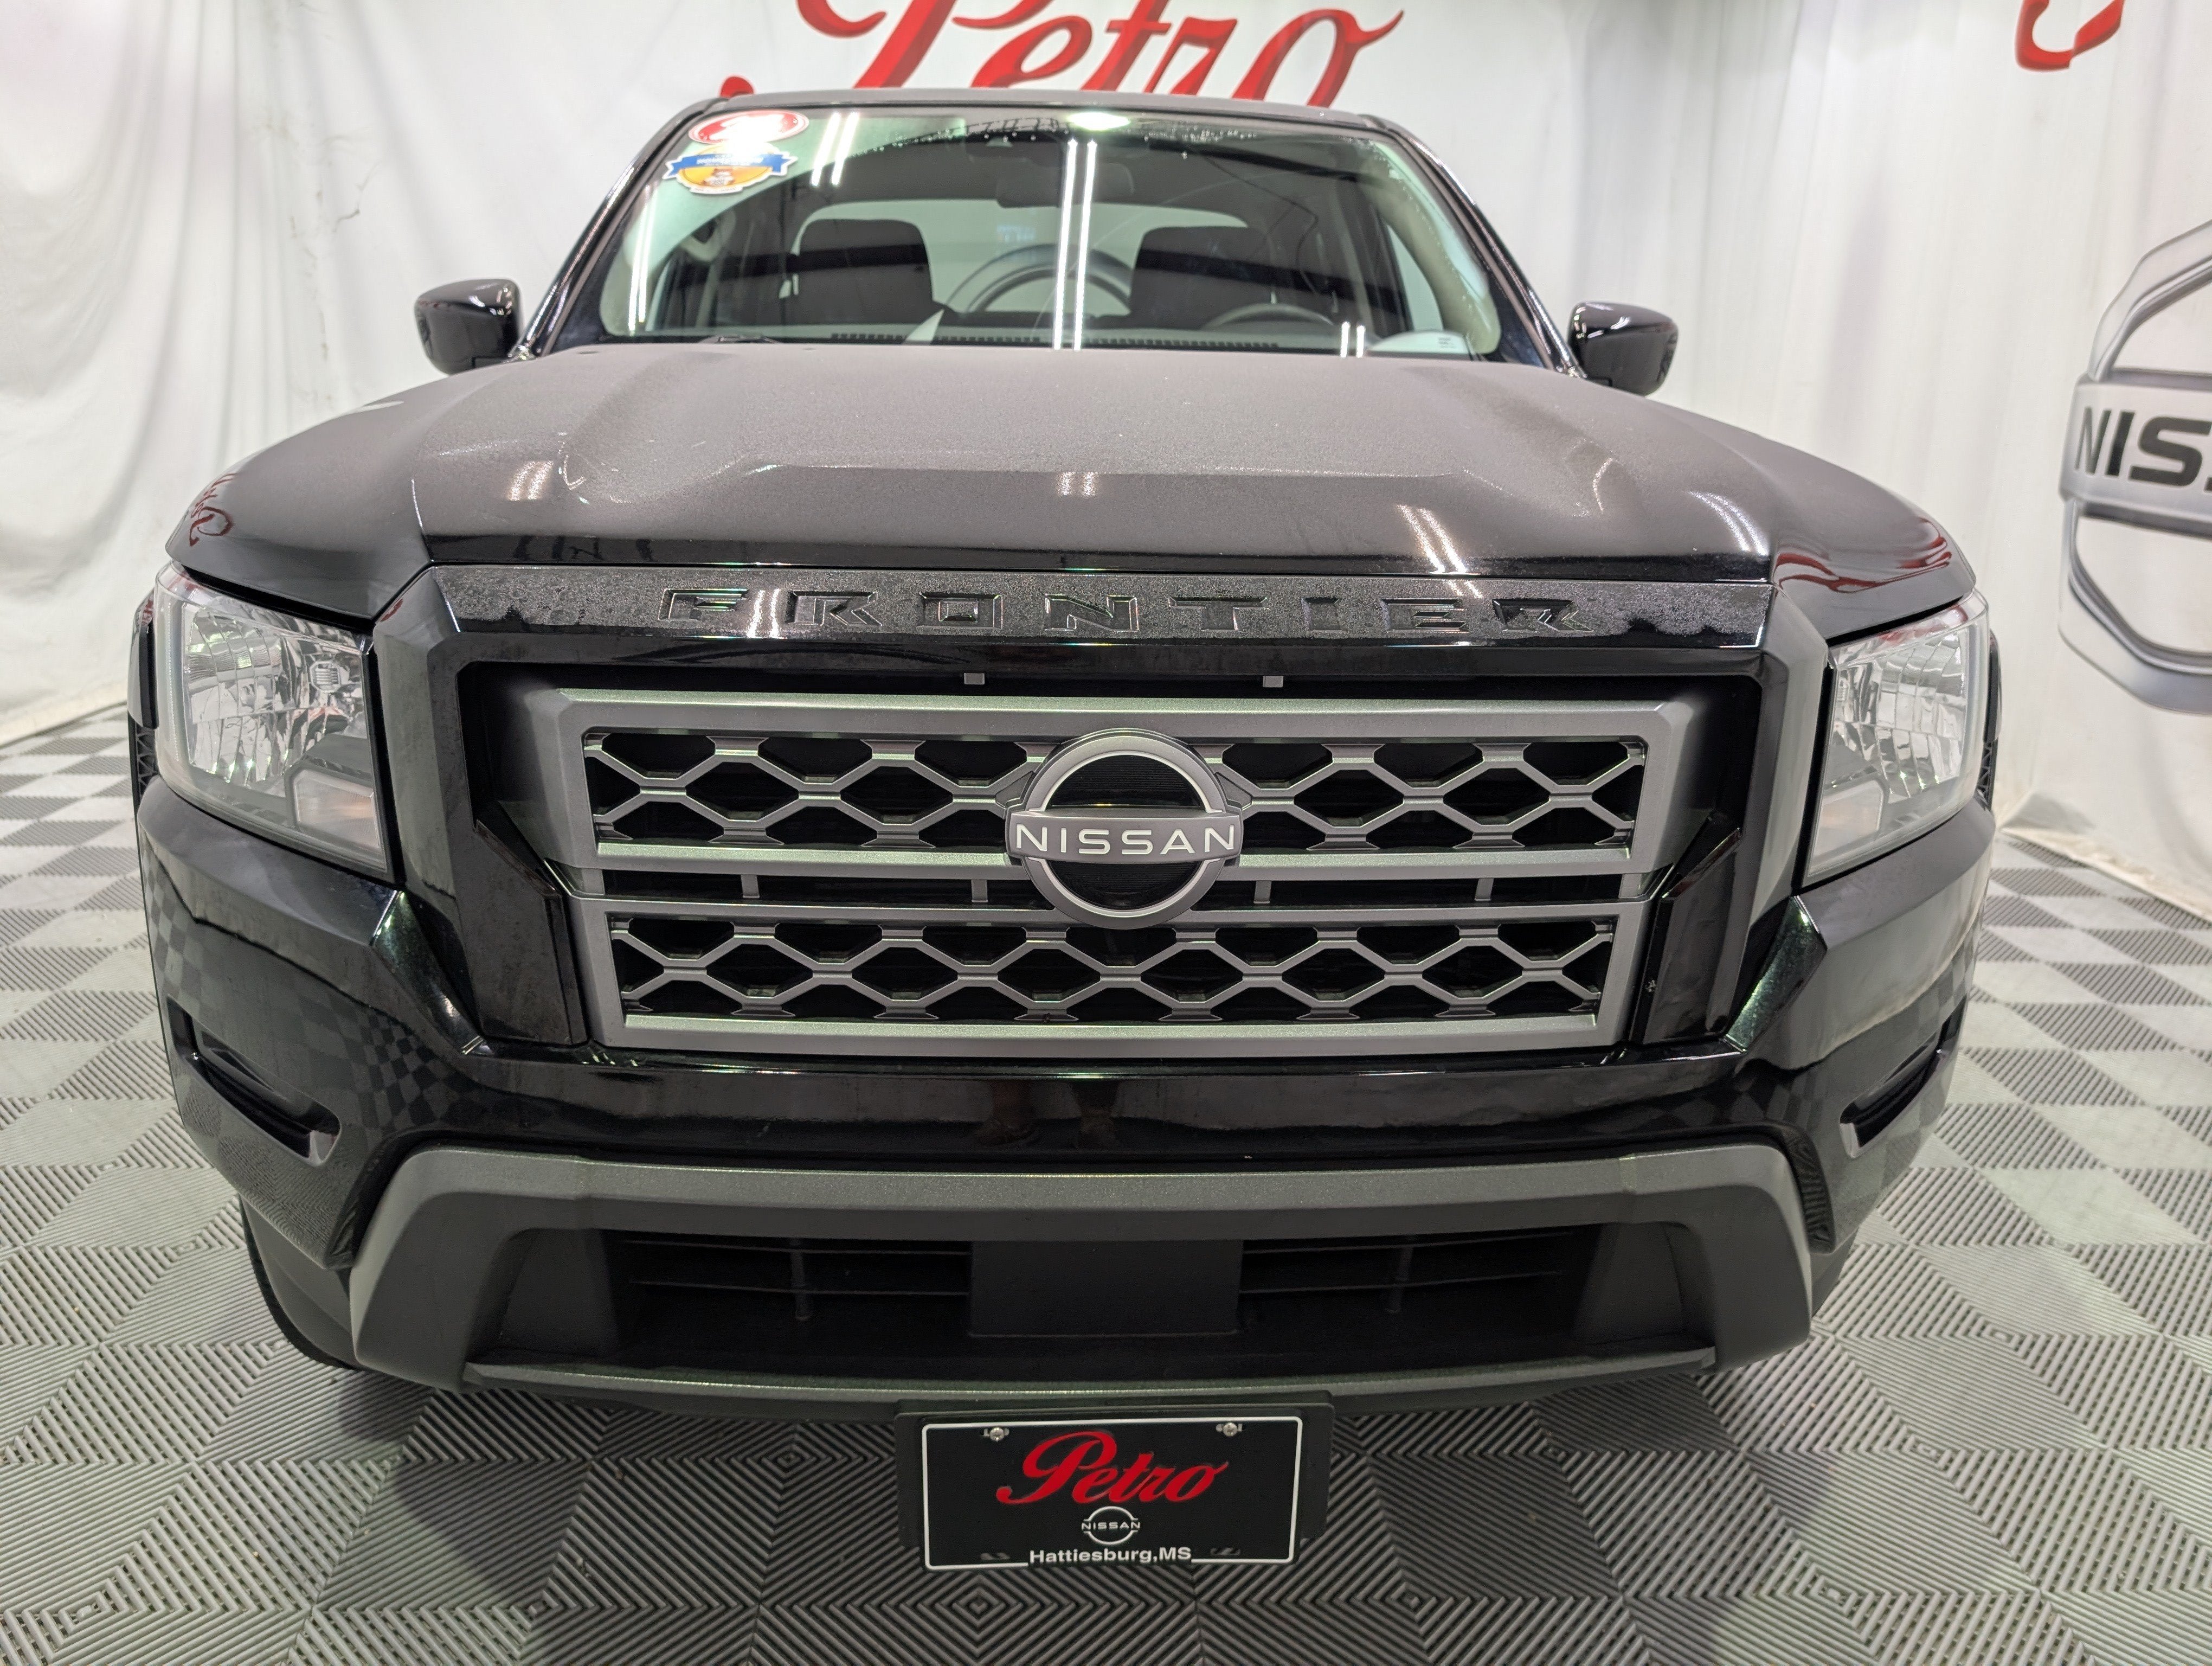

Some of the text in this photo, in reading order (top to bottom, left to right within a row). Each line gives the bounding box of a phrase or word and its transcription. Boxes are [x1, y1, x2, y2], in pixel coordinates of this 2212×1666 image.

[2074, 406, 2212, 492] NIS
[657, 588, 1595, 633] FRONTIER
[1015, 823, 1234, 855] NISSAN
[995, 1430, 1229, 1505] Petro
[1081, 1521, 1141, 1530] NISSAN
